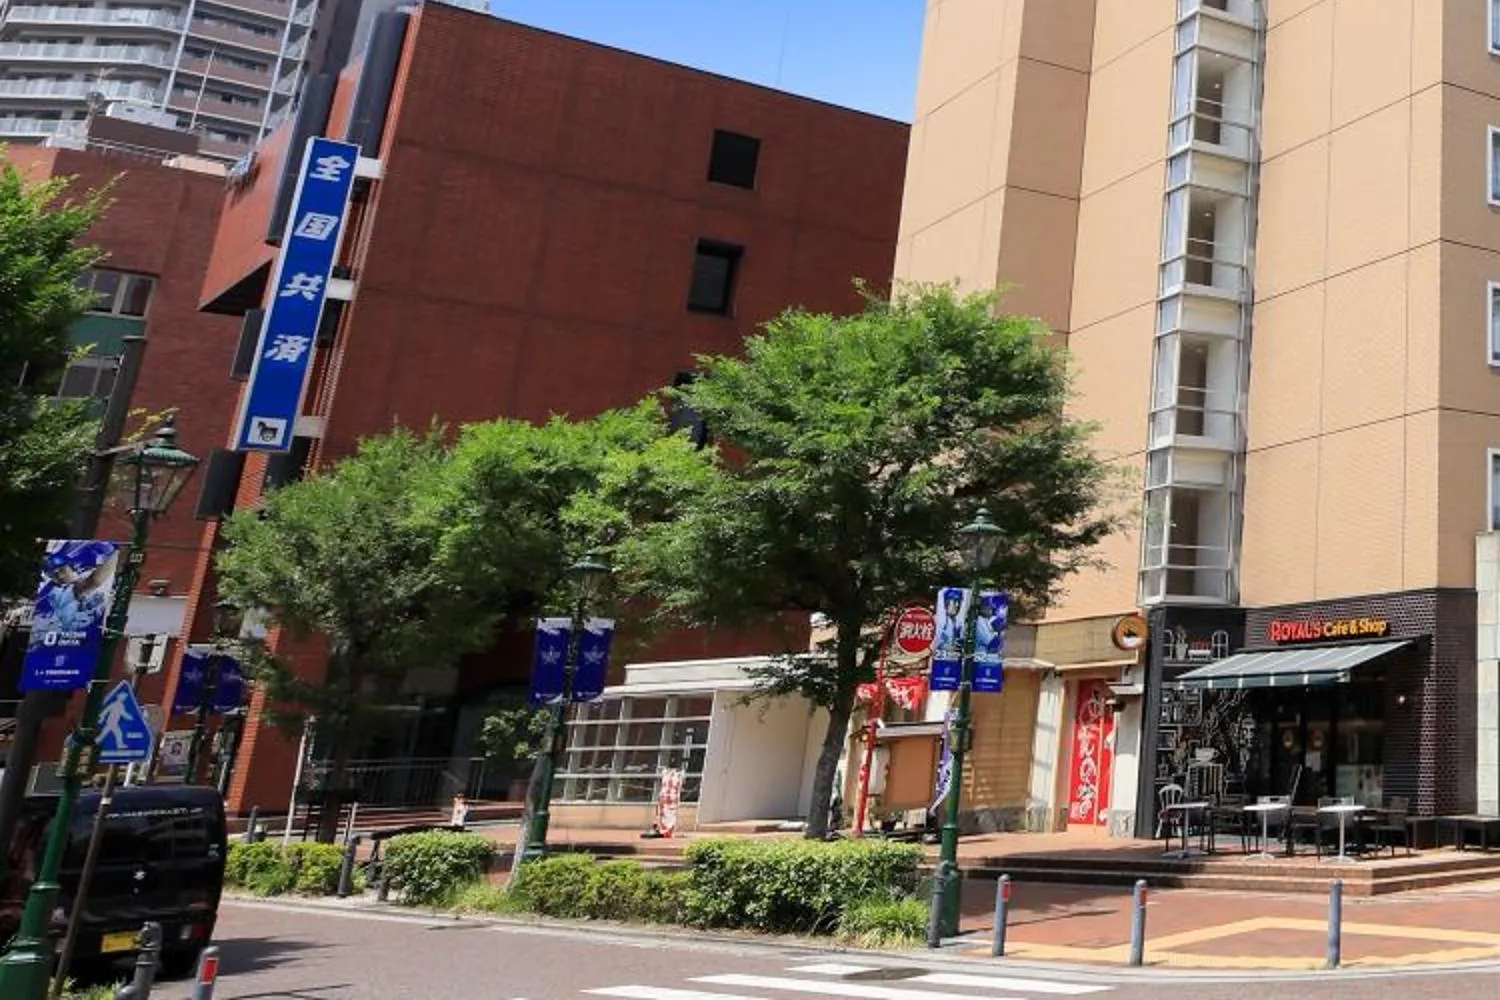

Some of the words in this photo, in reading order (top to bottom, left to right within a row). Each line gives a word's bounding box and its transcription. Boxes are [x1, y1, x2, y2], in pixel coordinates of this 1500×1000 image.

[264, 154, 352, 364] 全国共済
[1349, 620, 1358, 635] &
[1358, 618, 1388, 637] Shop
